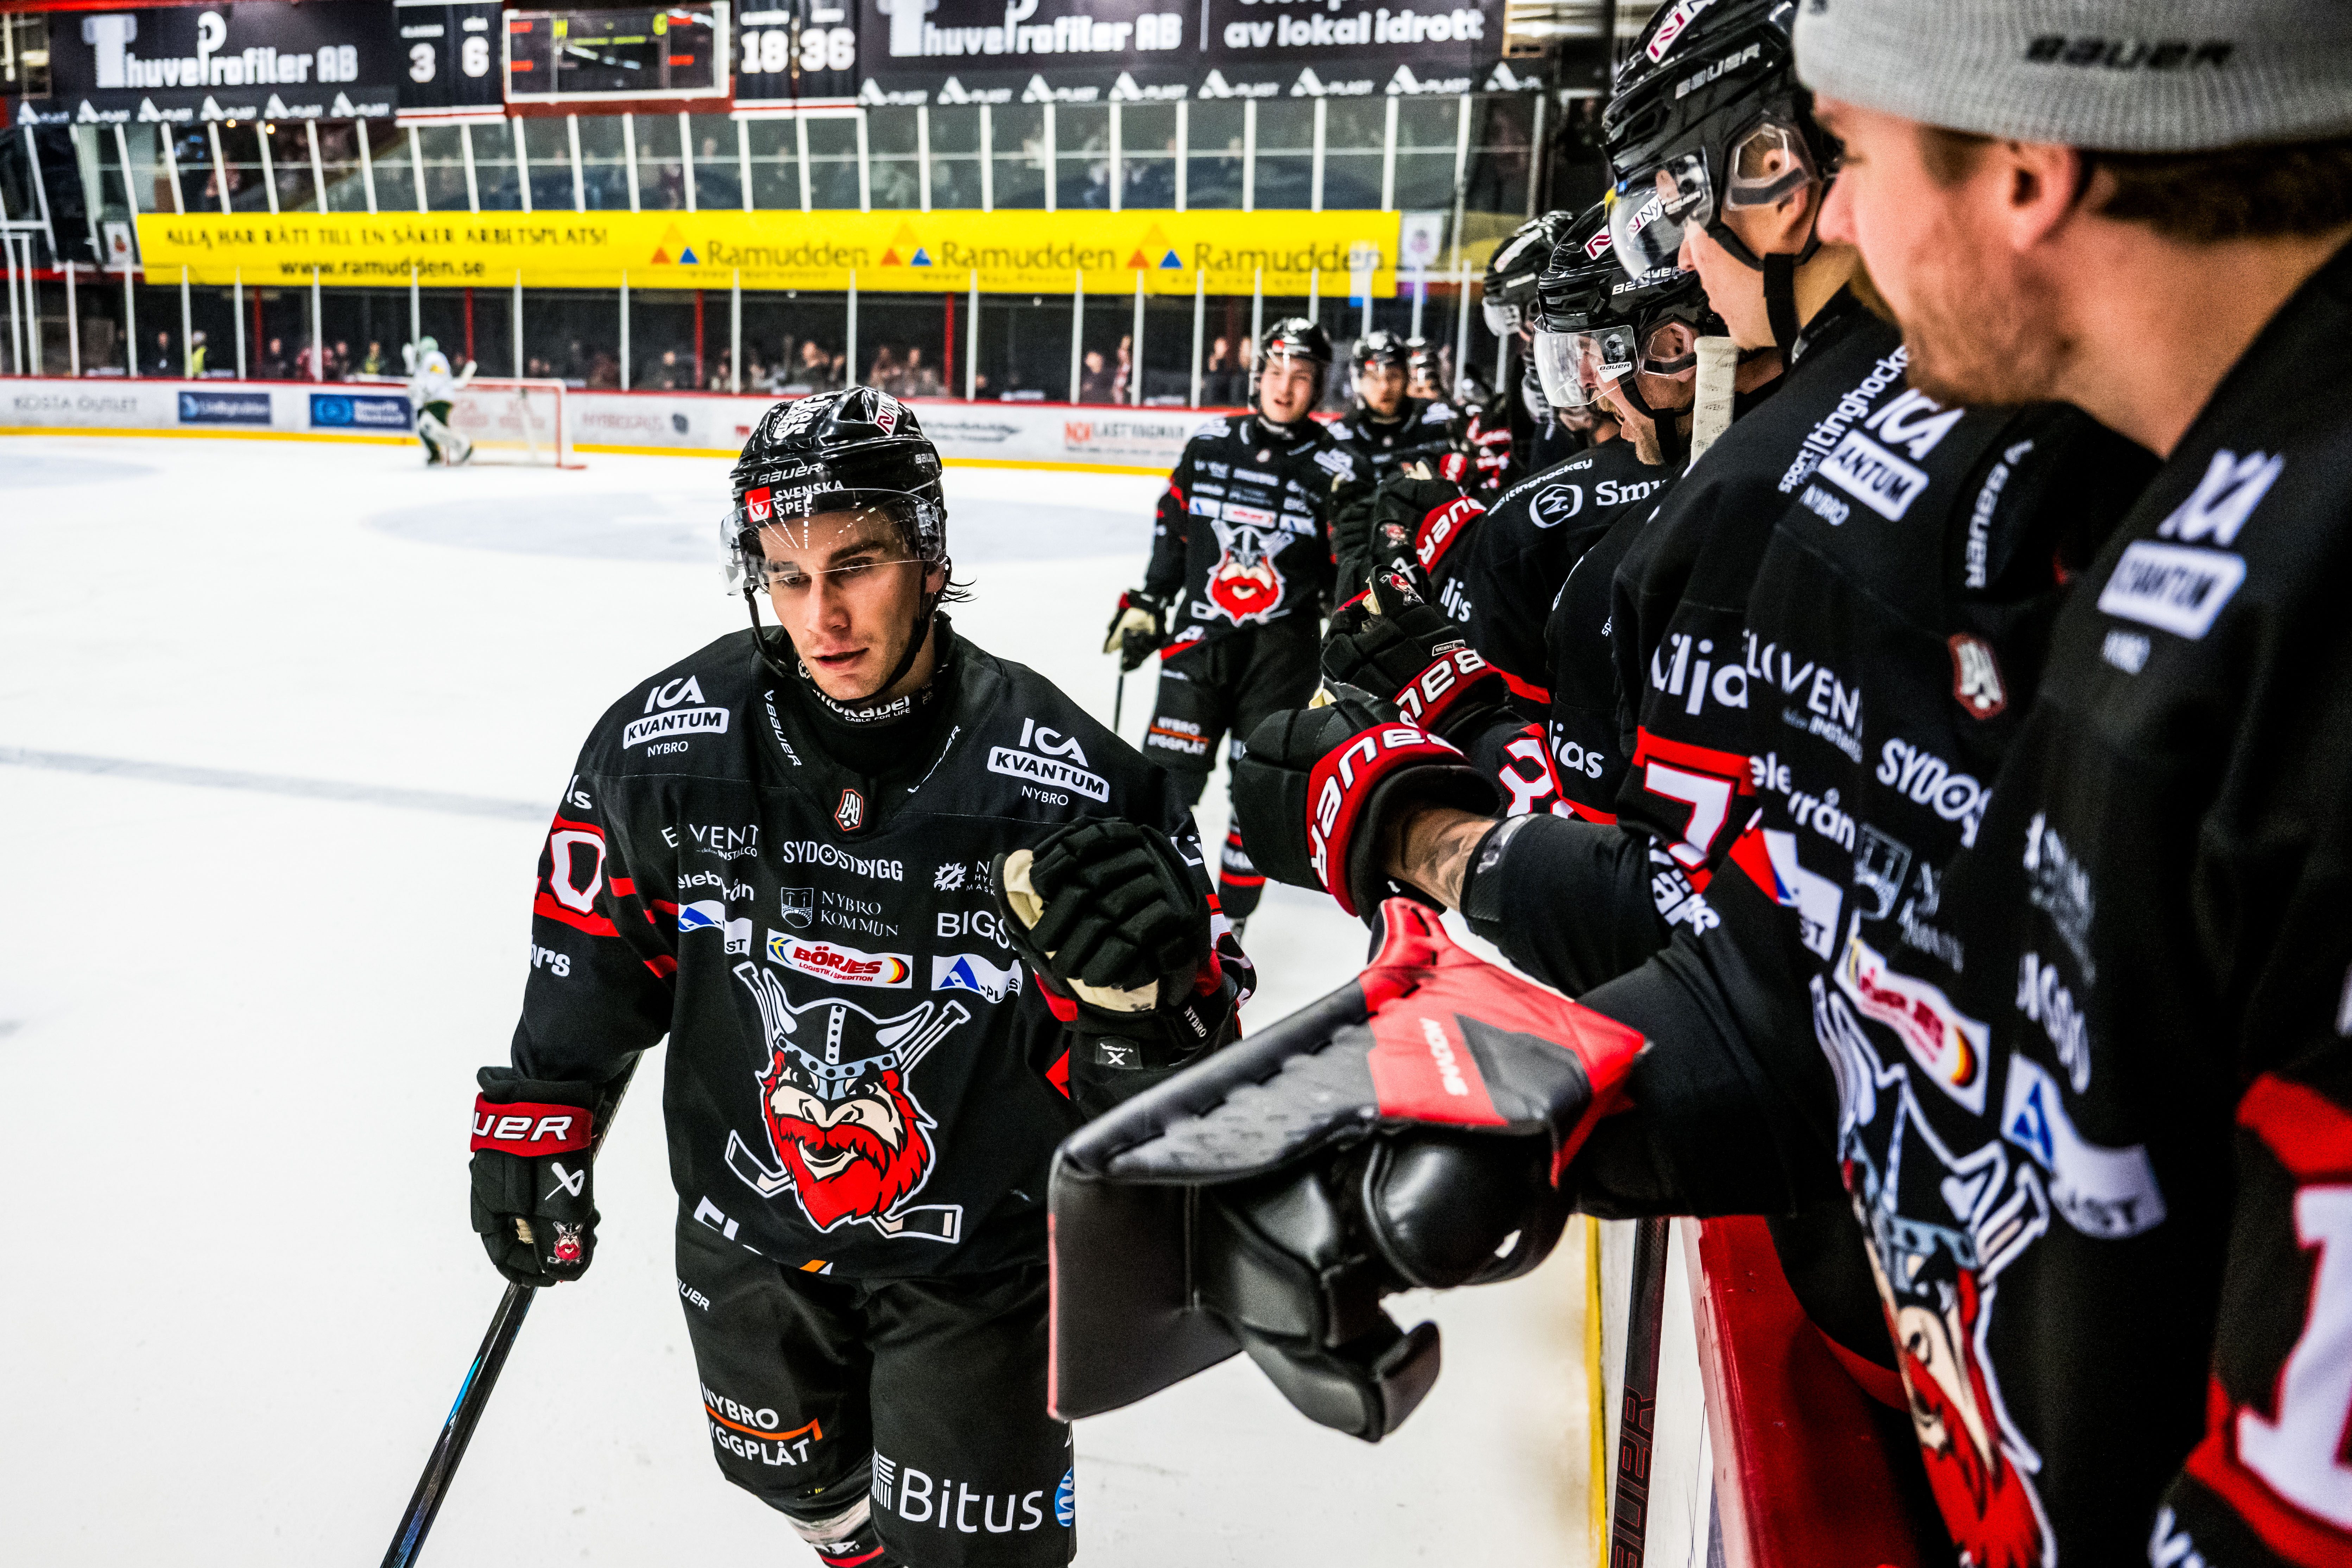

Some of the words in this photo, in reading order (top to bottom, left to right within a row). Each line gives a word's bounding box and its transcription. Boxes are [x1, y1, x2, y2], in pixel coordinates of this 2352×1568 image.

[1224, 22, 1274, 48] av
[1277, 12, 1372, 47] lokal
[1375, 8, 1485, 43] idrott
[409, 43, 436, 83] 3
[740, 30, 789, 73] 18
[799, 27, 855, 71] 36
[218, 228, 256, 245] HAR
[281, 256, 486, 277] www.ramudden.se
[707, 240, 870, 268] Ramudden
[941, 241, 1116, 272] Ramudden
[1194, 241, 1386, 274] Ramudden
[1864, 388, 1966, 461] ICA
[757, 462, 824, 485] BAUER
[775, 480, 845, 502] SVENSKA
[644, 675, 705, 714] ICA
[627, 712, 722, 742] KVANTUM
[894, 708, 911, 716] LIFE
[647, 741, 688, 757] NYBRO
[1019, 717, 1089, 767] ICA
[995, 752, 1105, 796] KVANTUM
[1022, 785, 1069, 806] NYBRO
[1645, 759, 1735, 870] 7
[822, 891, 881, 915] NYBRO
[821, 910, 898, 936] KOMMUN
[937, 910, 1017, 951] BIGS
[793, 946, 883, 974] BÖRJES
[1184, 1005, 1207, 1037] NYBRO
[472, 1115, 574, 1142] UER
[701, 1381, 779, 1430] NYBRO
[708, 1417, 810, 1466] YGGPLÅT
[899, 1467, 1043, 1533] Bitus
